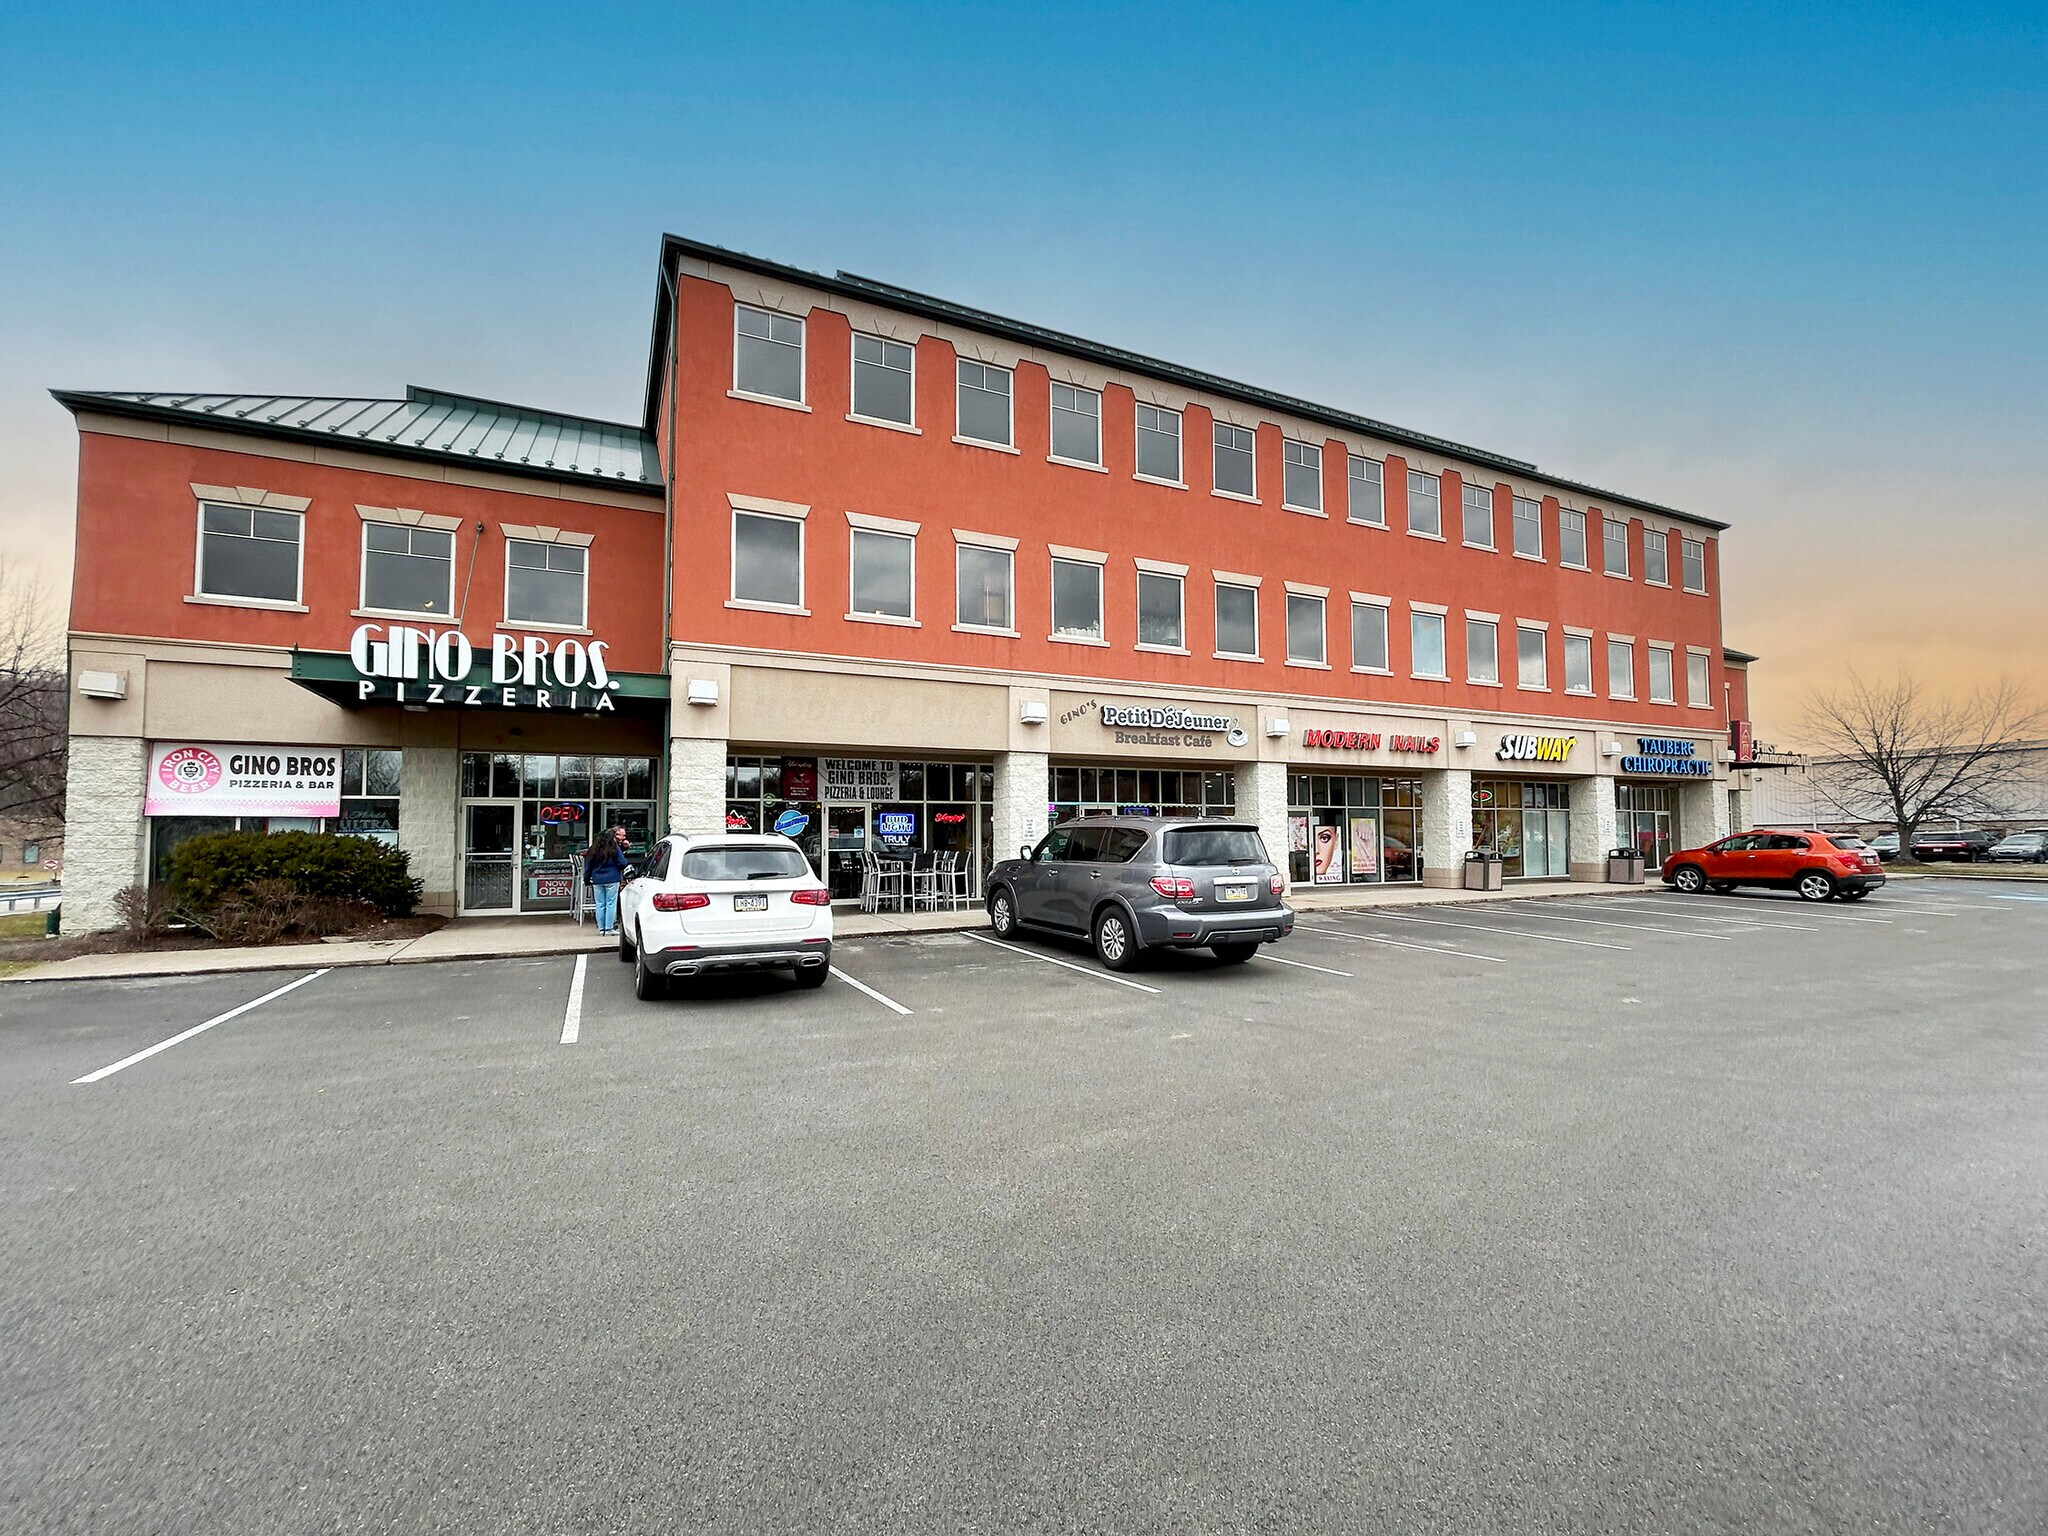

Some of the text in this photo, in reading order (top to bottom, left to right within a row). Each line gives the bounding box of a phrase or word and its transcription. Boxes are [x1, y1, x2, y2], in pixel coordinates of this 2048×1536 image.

[350, 623, 620, 690] GINO BROS.
[358, 680, 615, 711] PIZZERIA
[1060, 699, 1097, 725] GINO'S
[1104, 706, 1148, 723] Petit
[1114, 731, 1213, 747] Breakfast Café
[1303, 729, 1440, 753] MODERN NAILS
[1498, 734, 1578, 761] SUBWAY
[161, 749, 220, 773] IRON CITY
[229, 754, 336, 777] GINO BROS
[825, 759, 893, 771] WELCOME TO
[1622, 756, 1712, 776] CHIROPRACTIC
[229, 780, 335, 789] PIZZERIA & BAR
[828, 770, 891, 785] GINO BROS.
[168, 780, 211, 793] BEER
[824, 785, 857, 799] PIZZERIA
[859, 786, 865, 799] &
[867, 786, 894, 800] LOUNGE
[541, 806, 580, 820] OPEN
[885, 815, 909, 823] BUD
[339, 819, 394, 829] ULTRA
[882, 823, 912, 831] LIGHT
[883, 835, 911, 843] TRULY
[538, 886, 572, 896] OPEN
